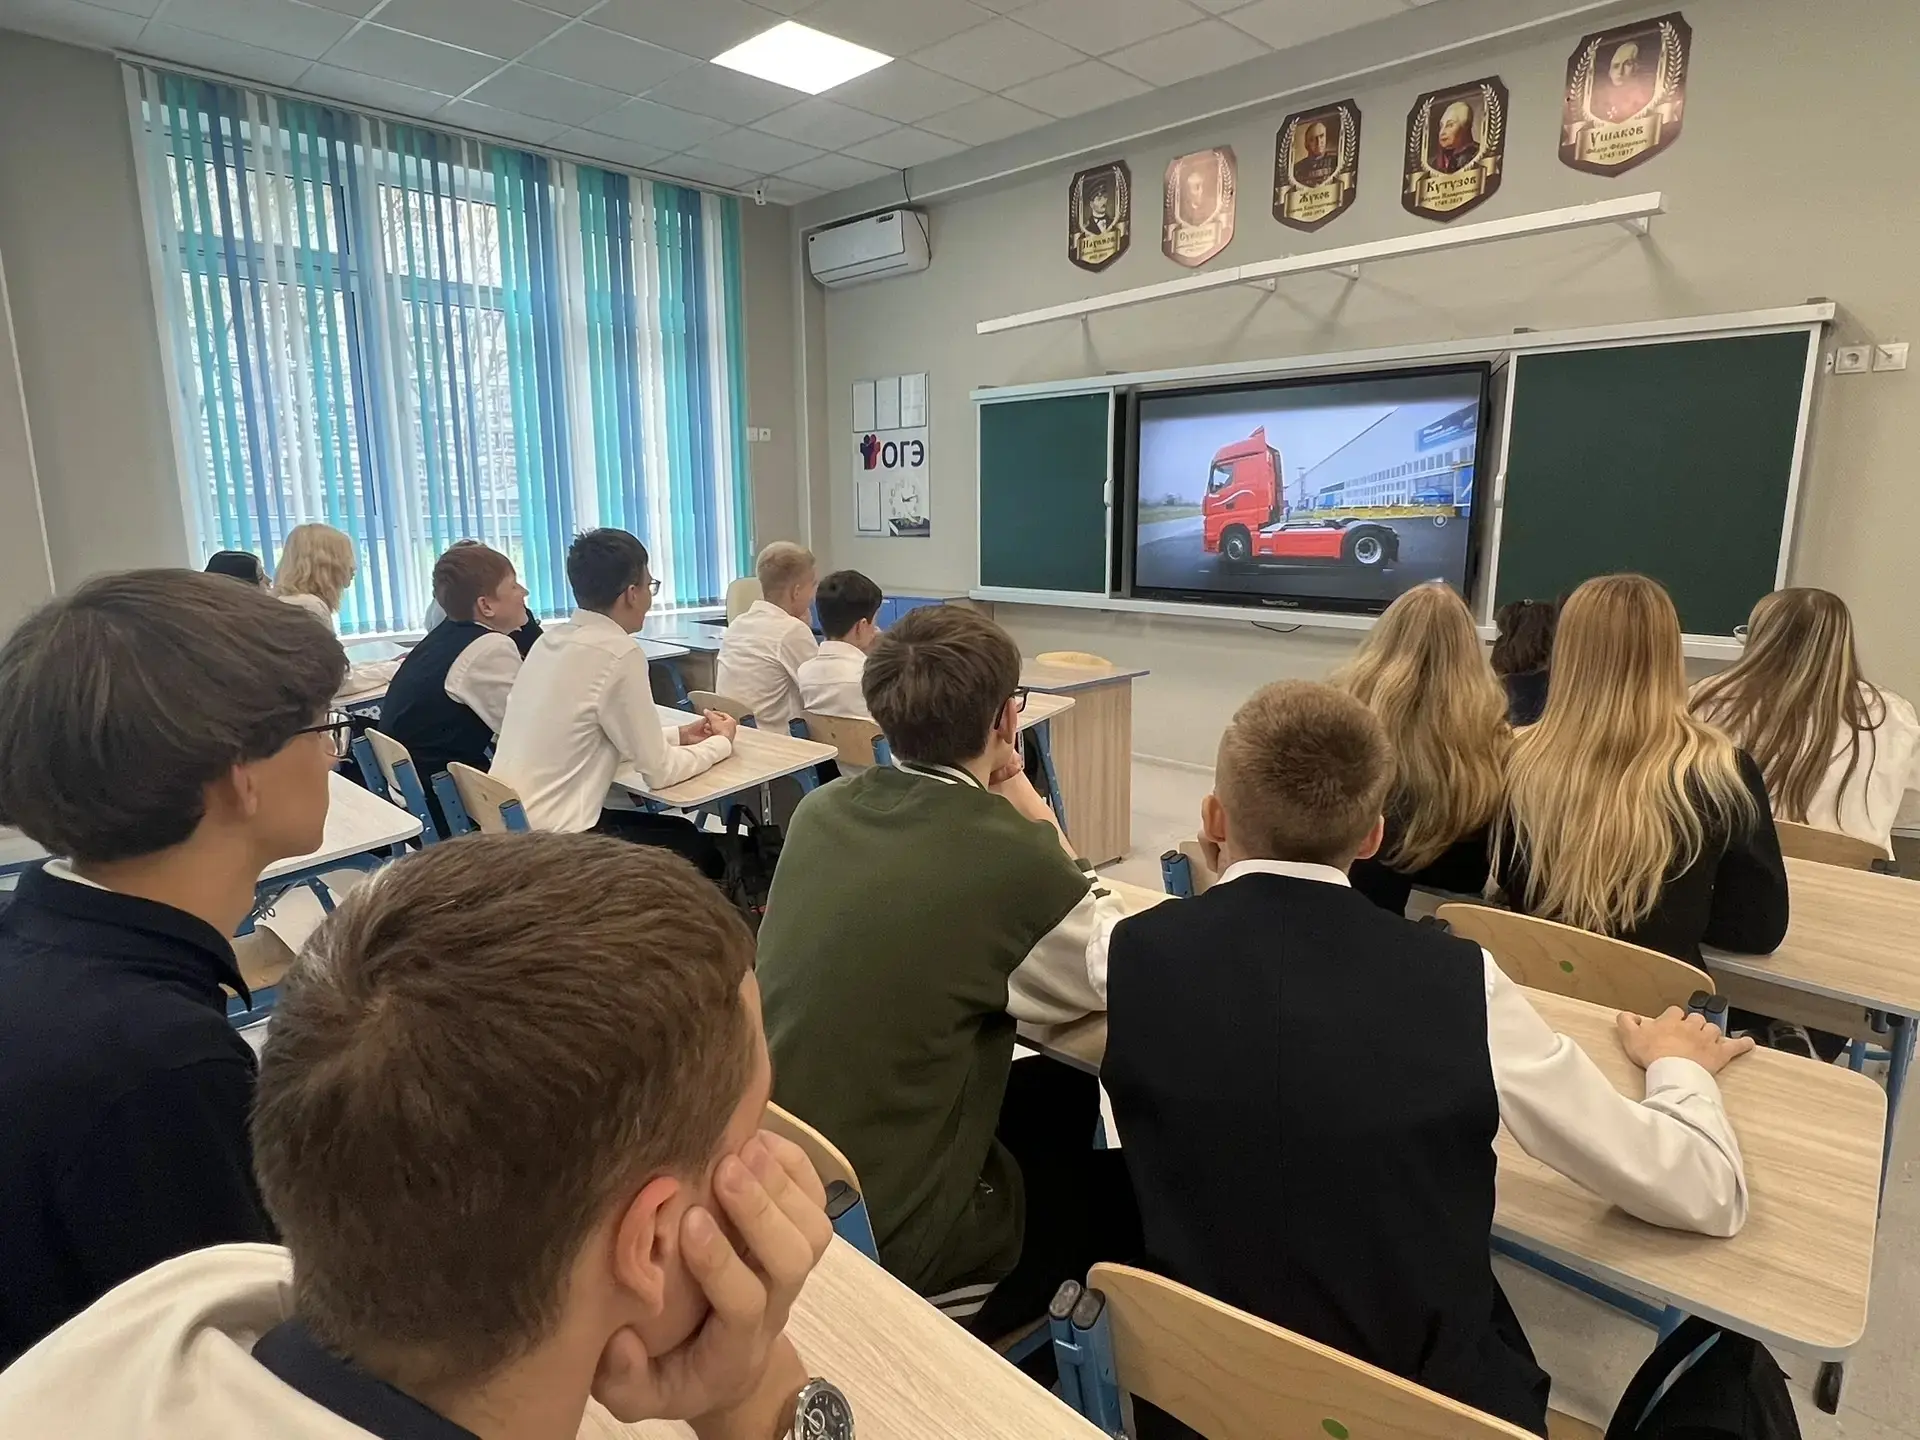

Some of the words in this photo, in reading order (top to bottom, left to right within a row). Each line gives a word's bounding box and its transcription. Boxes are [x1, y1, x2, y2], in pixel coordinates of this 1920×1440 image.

[1590, 126, 1645, 147] Ушаков
[1426, 176, 1477, 194] Кутузов
[1298, 191, 1330, 204] Жуков
[881, 439, 925, 469] ОГЭ
